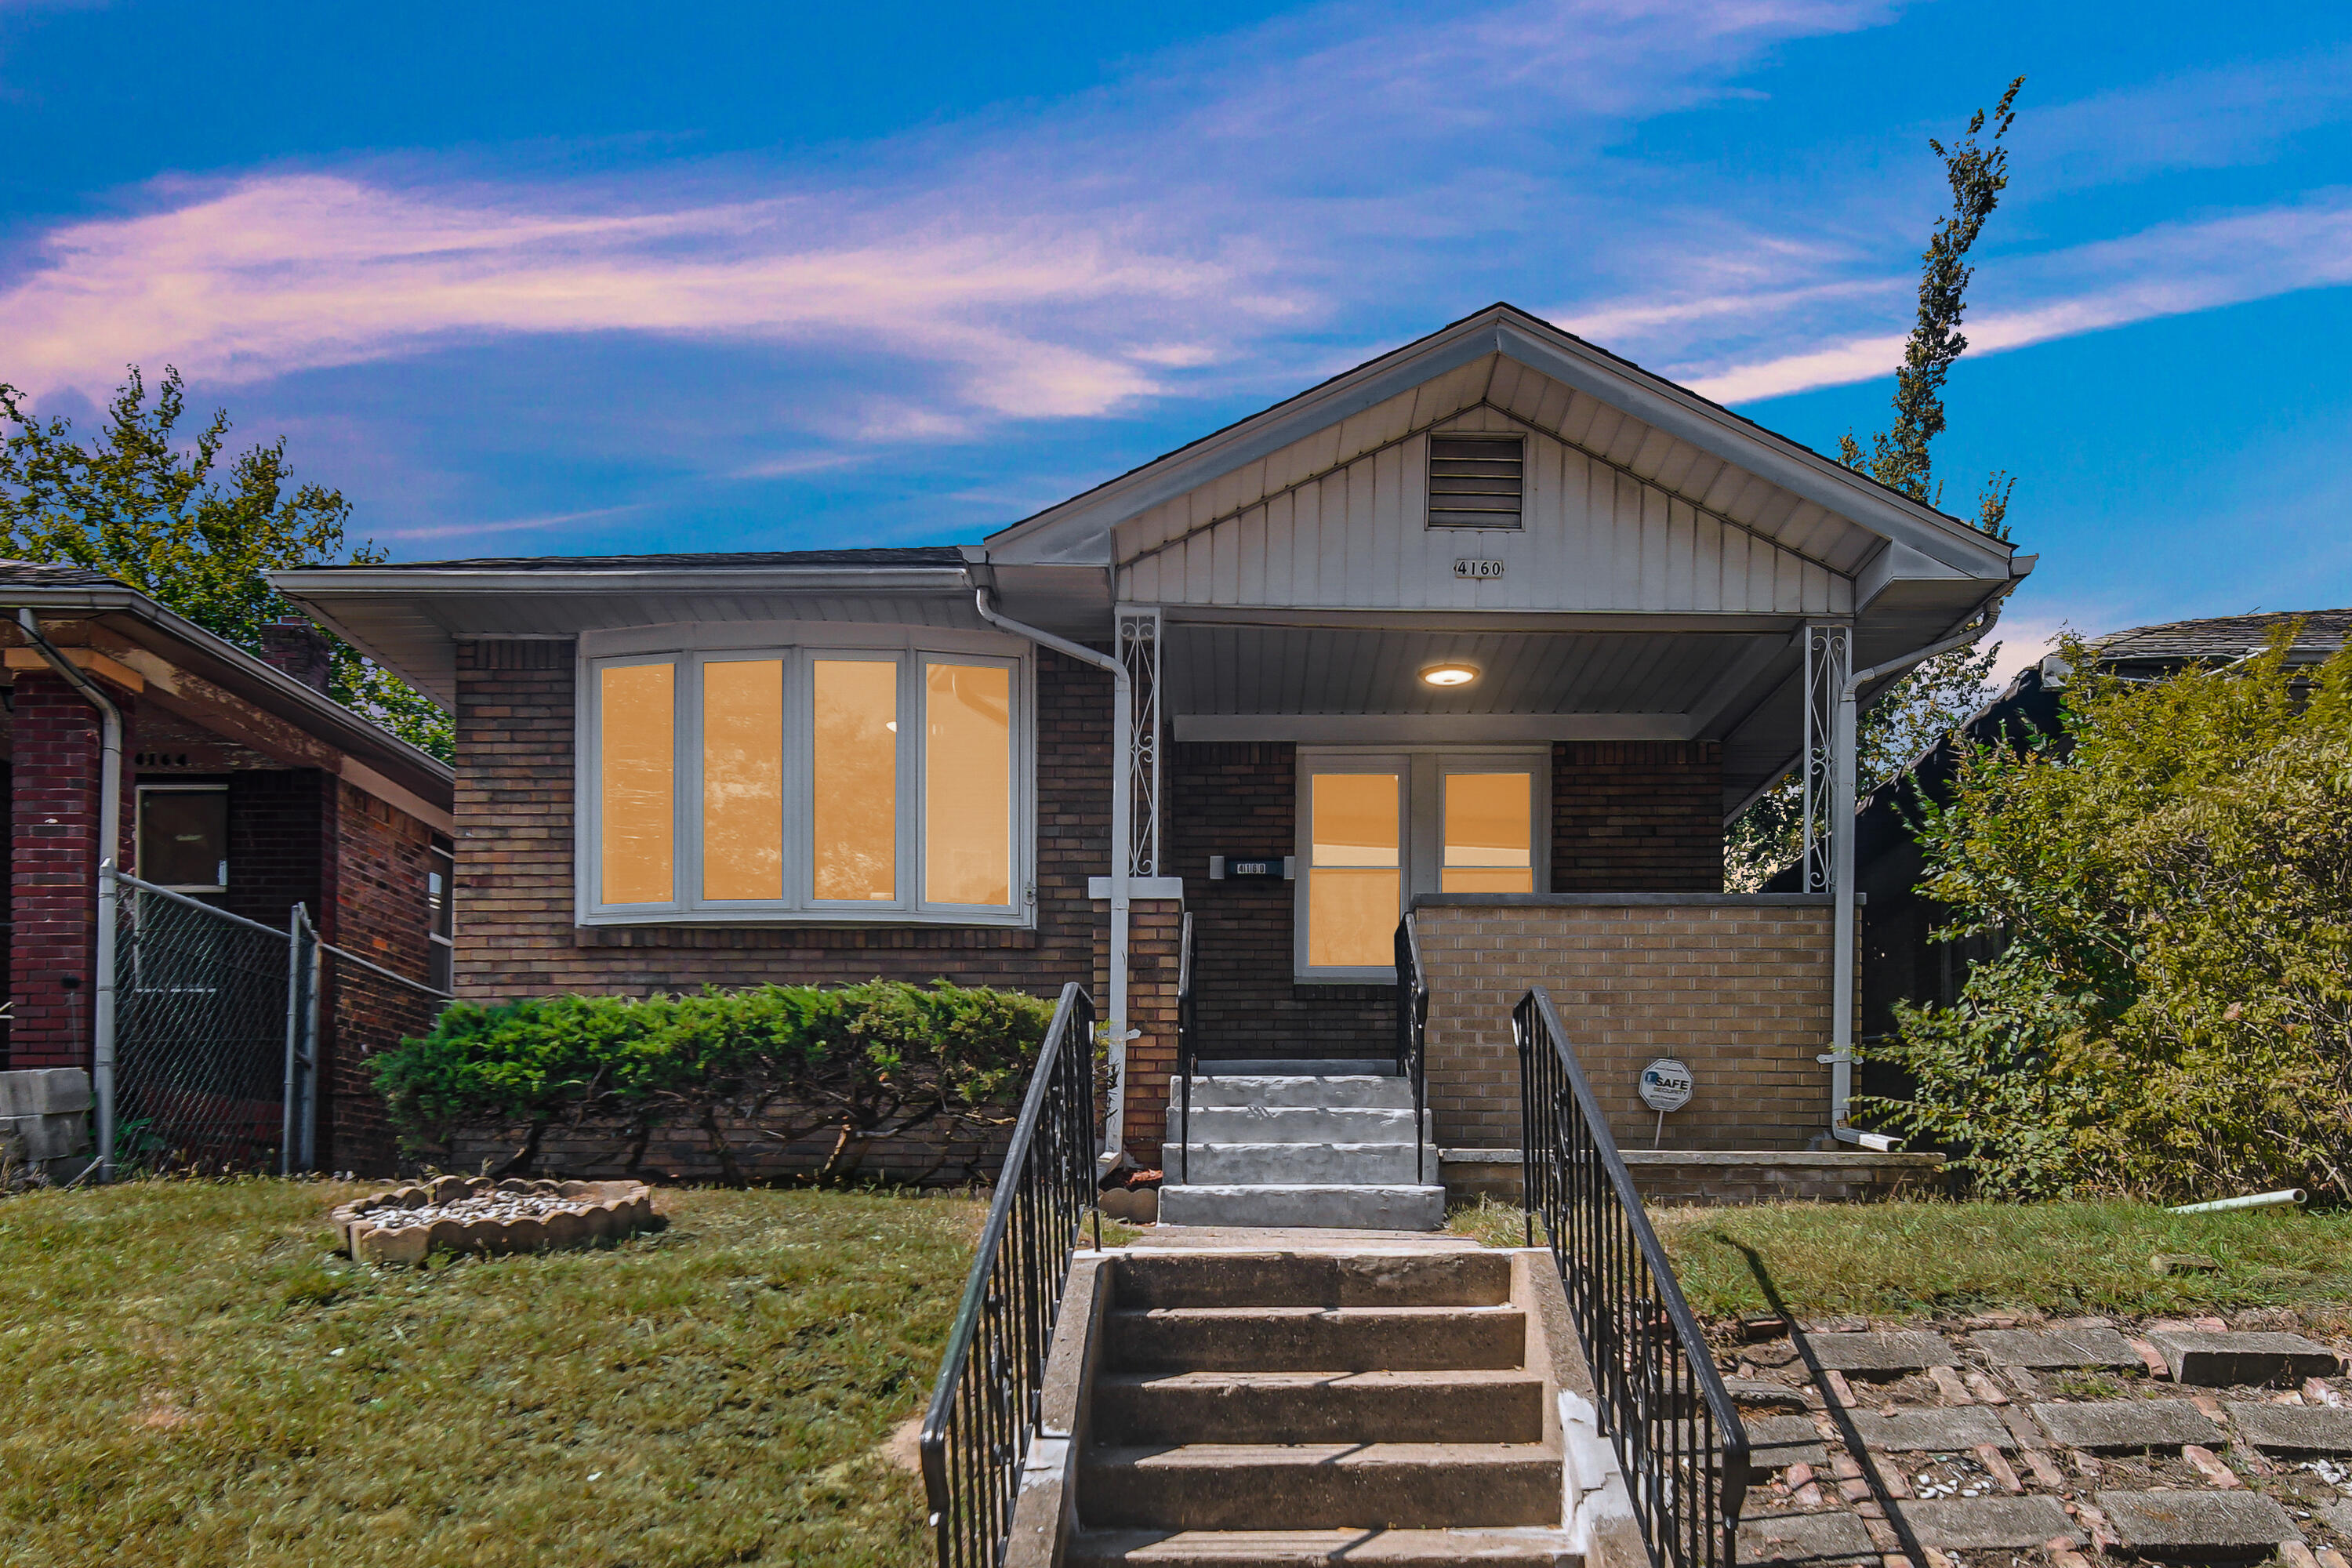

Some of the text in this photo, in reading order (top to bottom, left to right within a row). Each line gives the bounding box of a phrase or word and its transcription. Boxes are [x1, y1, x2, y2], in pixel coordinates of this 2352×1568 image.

[1457, 561, 1501, 575] 4160
[1238, 863, 1265, 874] 4160
[1655, 1076, 1689, 1090] SAFE
